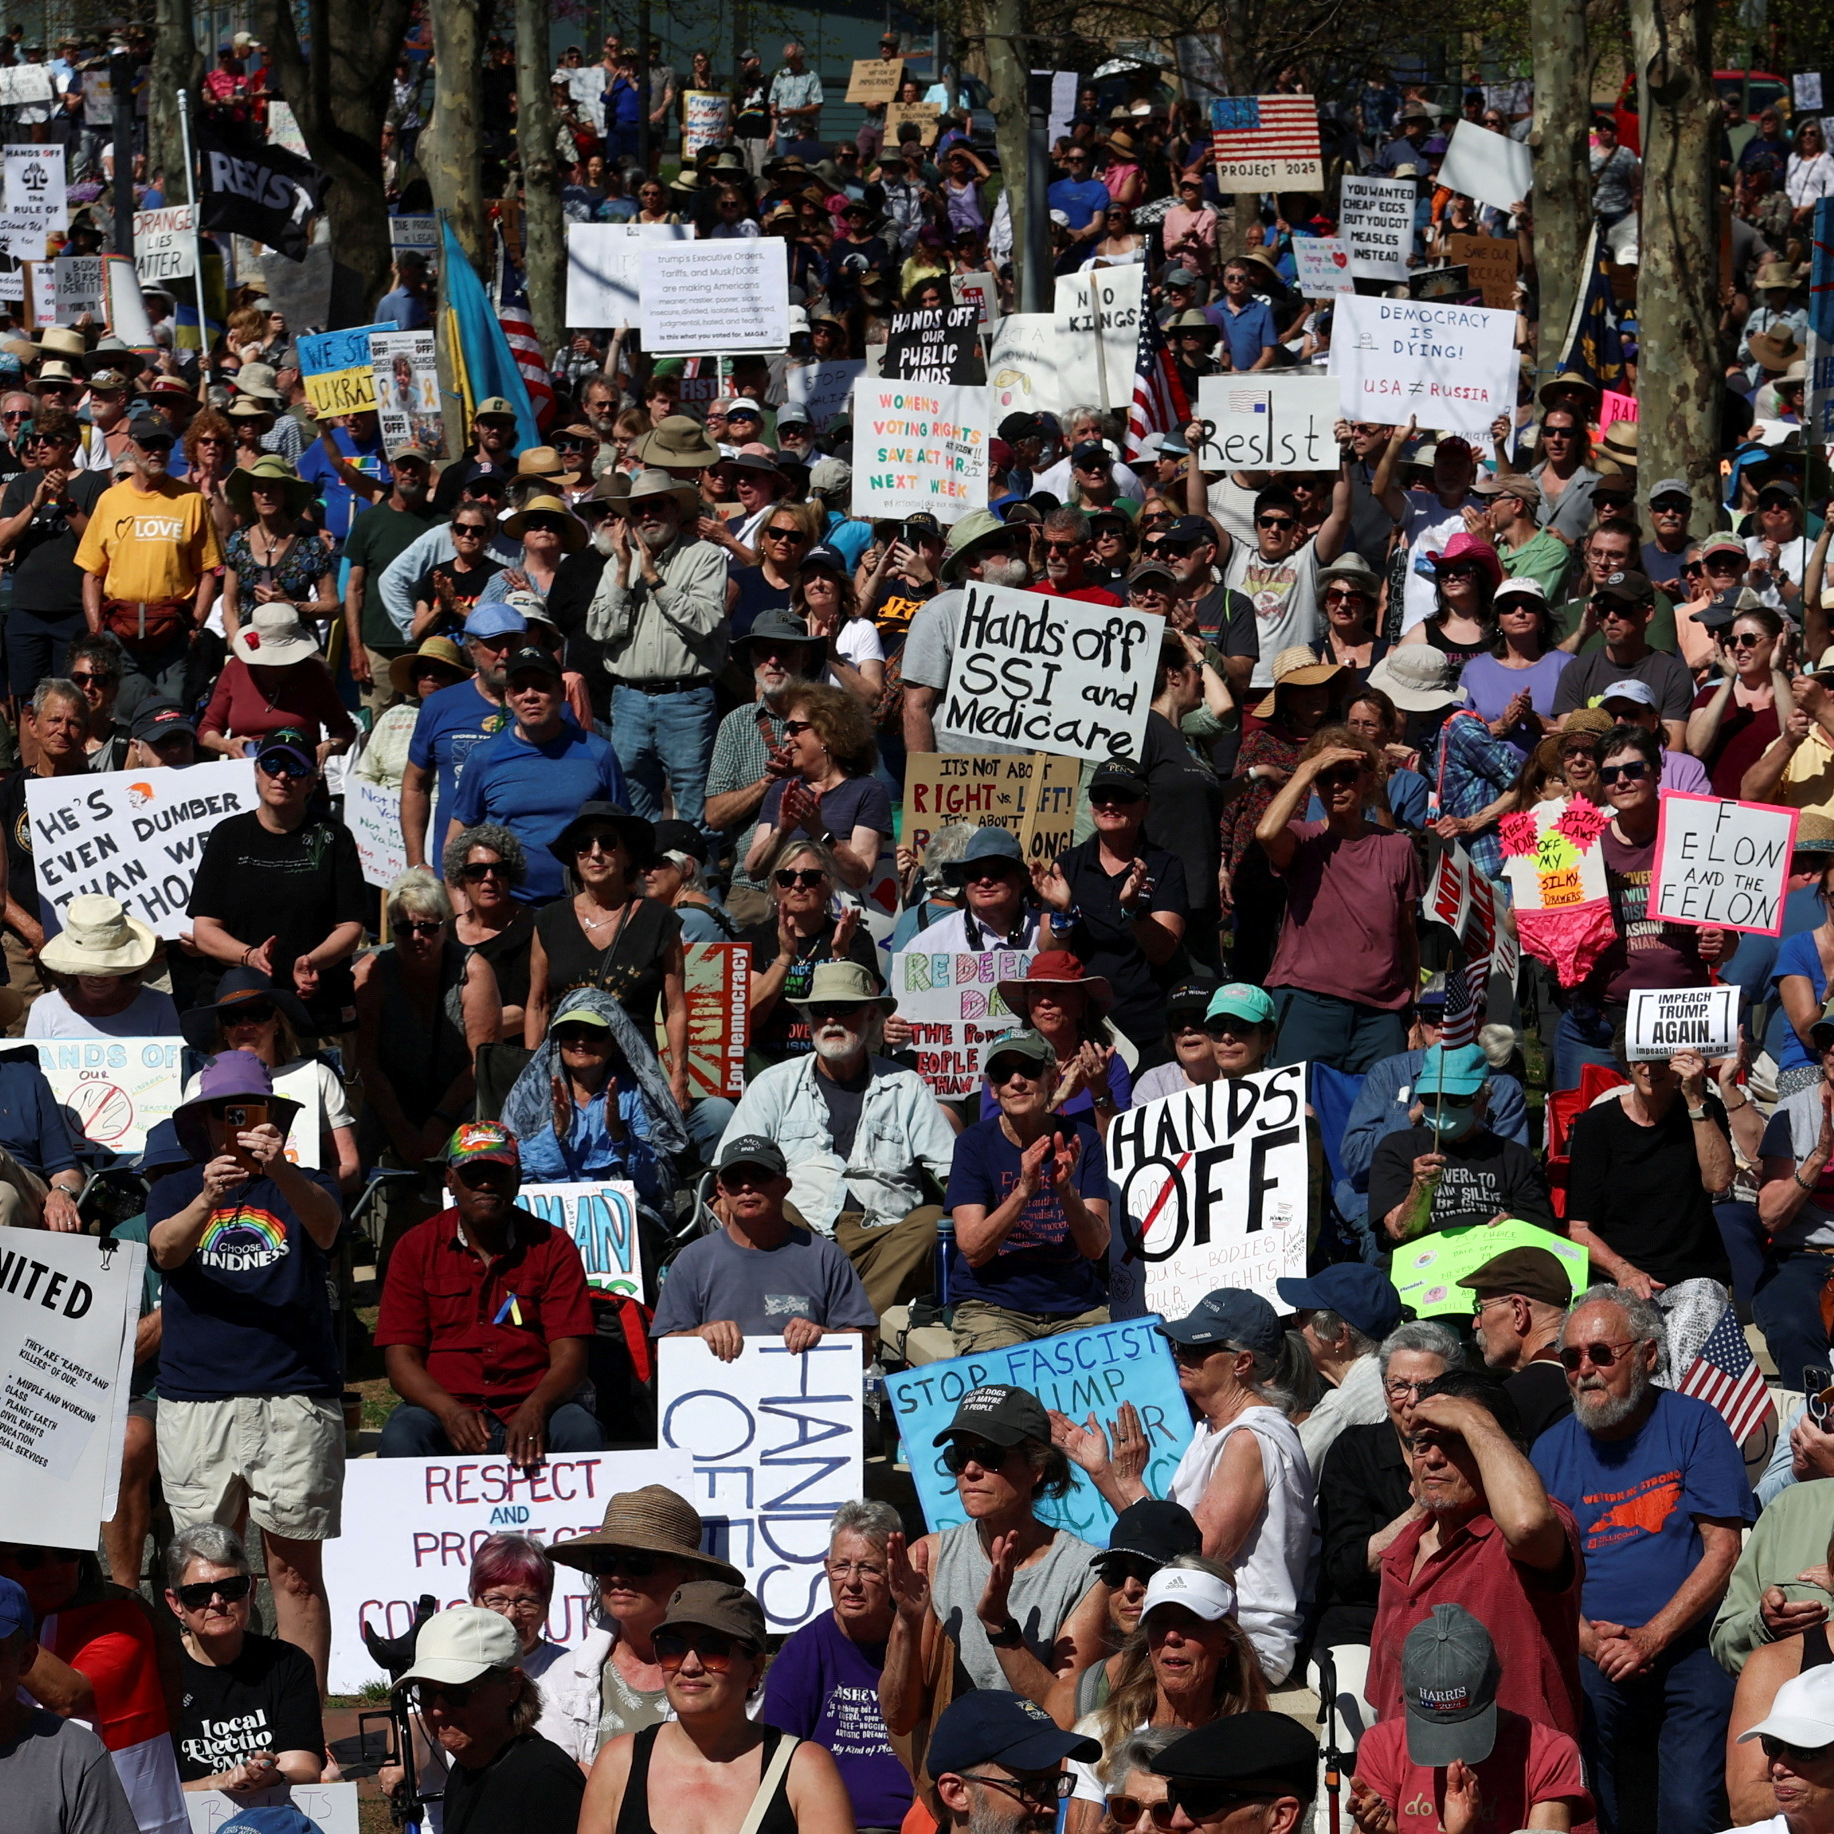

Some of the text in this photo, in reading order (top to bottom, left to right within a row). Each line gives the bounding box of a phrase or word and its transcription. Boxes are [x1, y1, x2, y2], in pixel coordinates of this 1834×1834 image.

[1221, 162, 1315, 177] PROJECT 2025
[209, 153, 314, 225] RESIST
[1347, 185, 1414, 200] YOU WANTED
[1343, 199, 1375, 210] CHEAP
[1344, 214, 1409, 229] BUT YOU GOT
[1351, 232, 1399, 245] MEASLES
[693, 254, 731, 262] Executive
[1354, 249, 1398, 262] INSTEAD
[711, 267, 759, 276] Musk/DOGE
[679, 284, 711, 293] making
[714, 282, 759, 290] Americans
[891, 307, 975, 333] HANDS OFF
[1381, 306, 1489, 328] DEMOCRACY
[922, 330, 945, 343] OUR
[1410, 328, 1433, 339] IS
[899, 344, 958, 367] PUBLIC
[1393, 339, 1464, 359] DYING!
[1431, 383, 1488, 402] RUSSIA
[880, 395, 938, 414] WOMEN'S
[874, 420, 980, 444] VOTING RIGHTS
[870, 474, 967, 498] NEXT WEEK
[961, 589, 1144, 671] Hands off
[961, 651, 1136, 716] SSI and
[946, 696, 1133, 755] Medicare
[1681, 834, 1785, 868] ELON
[1685, 868, 1764, 892] AND THE
[1659, 881, 1779, 931] FELON
[1659, 992, 1711, 1004] IMPEACH
[1658, 1004, 1709, 1019] TRUMP.
[1653, 1021, 1715, 1043] AGAIN.
[1420, 1687, 1466, 1701] HARRIS
